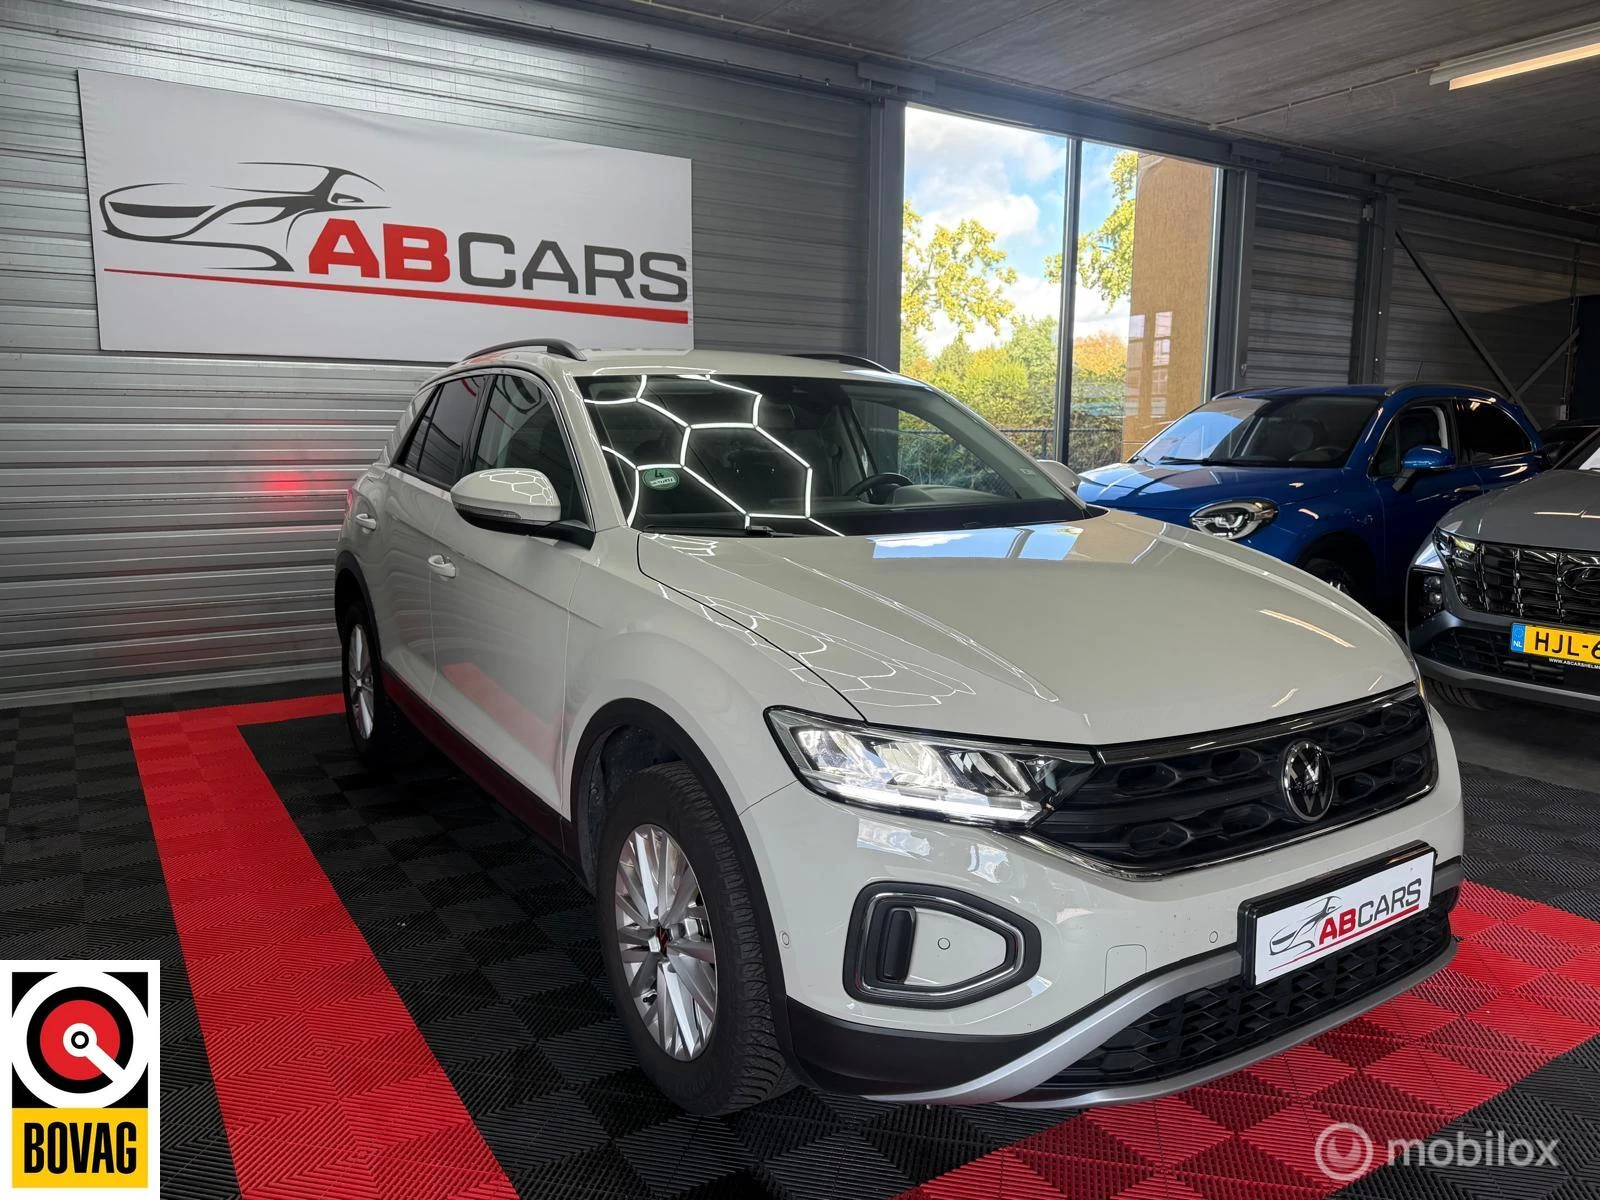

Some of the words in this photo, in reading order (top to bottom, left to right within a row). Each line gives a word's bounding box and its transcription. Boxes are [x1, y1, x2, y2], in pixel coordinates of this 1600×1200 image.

[308, 217, 688, 303] ABCARS
[654, 468, 665, 479] 4
[1513, 640, 1523, 648] NL
[1318, 877, 1422, 946] ABCARS
